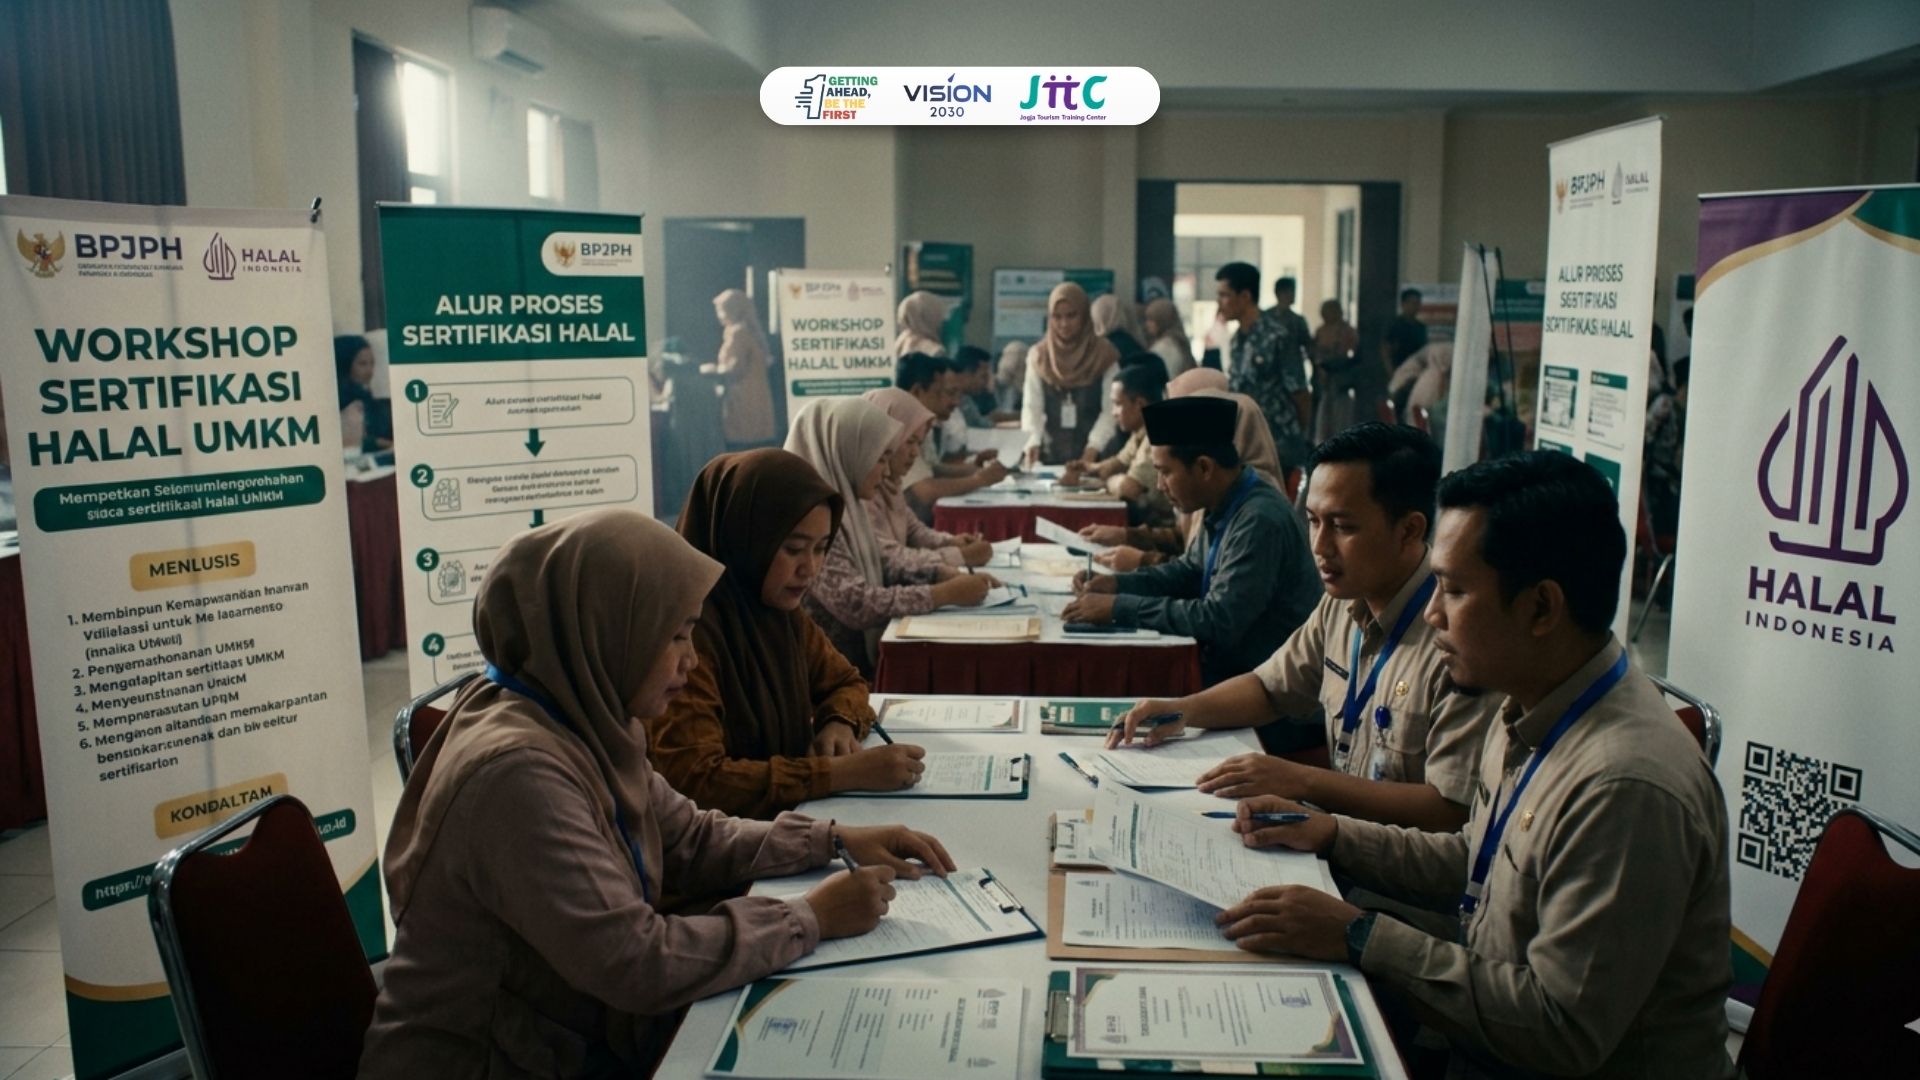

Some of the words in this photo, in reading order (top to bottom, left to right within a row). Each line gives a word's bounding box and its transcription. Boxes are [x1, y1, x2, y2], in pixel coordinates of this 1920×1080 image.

[75, 233, 182, 260] BPJPH
[580, 242, 633, 257] BP2PH
[241, 248, 301, 263] HALAL
[243, 265, 302, 273] INDONESIA
[435, 295, 503, 315] ALUR
[510, 294, 604, 314] PROSES
[792, 318, 884, 332] WORKSHOP
[402, 323, 552, 346] SERTIFIKASI
[559, 322, 636, 342] HALAL
[35, 326, 297, 363] WORKSHOP
[791, 337, 885, 351] SERTIFIKASI
[788, 356, 839, 370] HALAL
[843, 355, 891, 369] UMKM
[39, 371, 302, 415] SERTIFIKASI
[412, 384, 420, 398] 1
[28, 424, 182, 466] HALAL
[194, 415, 320, 454] UMKM
[416, 469, 428, 484] 2
[149, 553, 241, 578] MENLUSIS
[423, 553, 434, 567] 3
[1748, 565, 1897, 625] HALAL
[68, 614, 79, 626] 1.
[153, 613, 192, 631] untuk
[1745, 610, 1895, 653] INDONESIA
[427, 637, 440, 652] 4
[72, 668, 84, 679] 2.
[74, 684, 86, 697] 3.
[75, 702, 89, 714] 4.
[77, 720, 90, 732] 5.
[217, 724, 241, 739] dan
[79, 737, 92, 749] 6.
